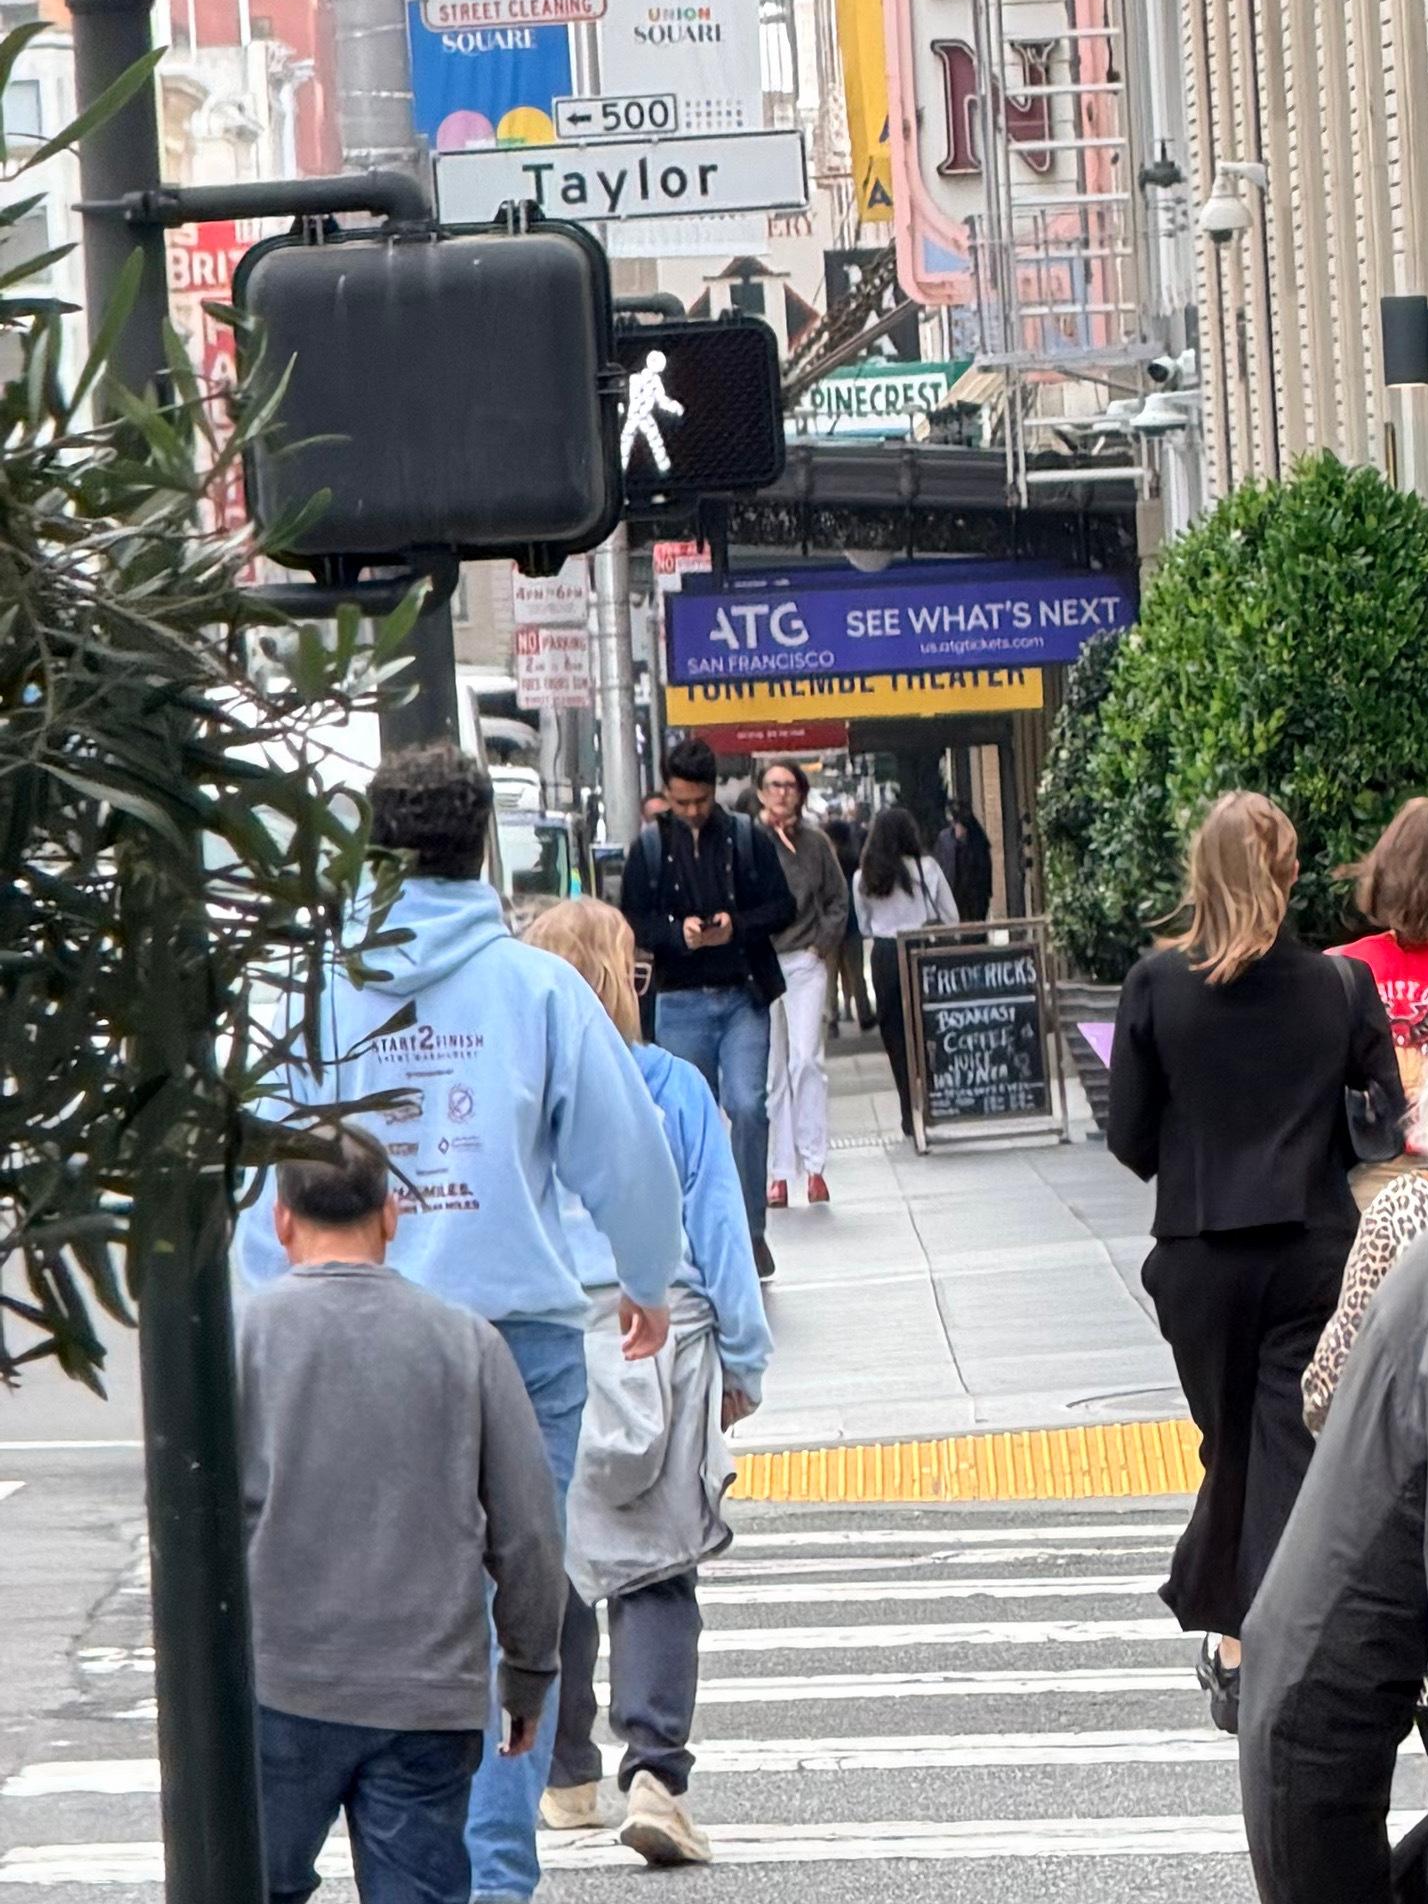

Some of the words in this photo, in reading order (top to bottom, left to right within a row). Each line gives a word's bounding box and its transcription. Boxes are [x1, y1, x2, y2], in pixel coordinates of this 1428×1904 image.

[439, 0, 501, 24] STREET
[648, 6, 713, 22] UNION
[441, 28, 539, 56] SQUARE
[634, 24, 728, 49] SQUARE
[601, 99, 670, 133] 500
[521, 156, 719, 214] Taylor
[810, 380, 943, 419] PINECREST
[709, 602, 810, 650] ATG
[846, 608, 901, 638] SEE
[907, 599, 1032, 635] WHAT'S
[1039, 596, 1120, 628] NEXT
[687, 656, 724, 676] SAN
[728, 649, 836, 674] FRANCISCO
